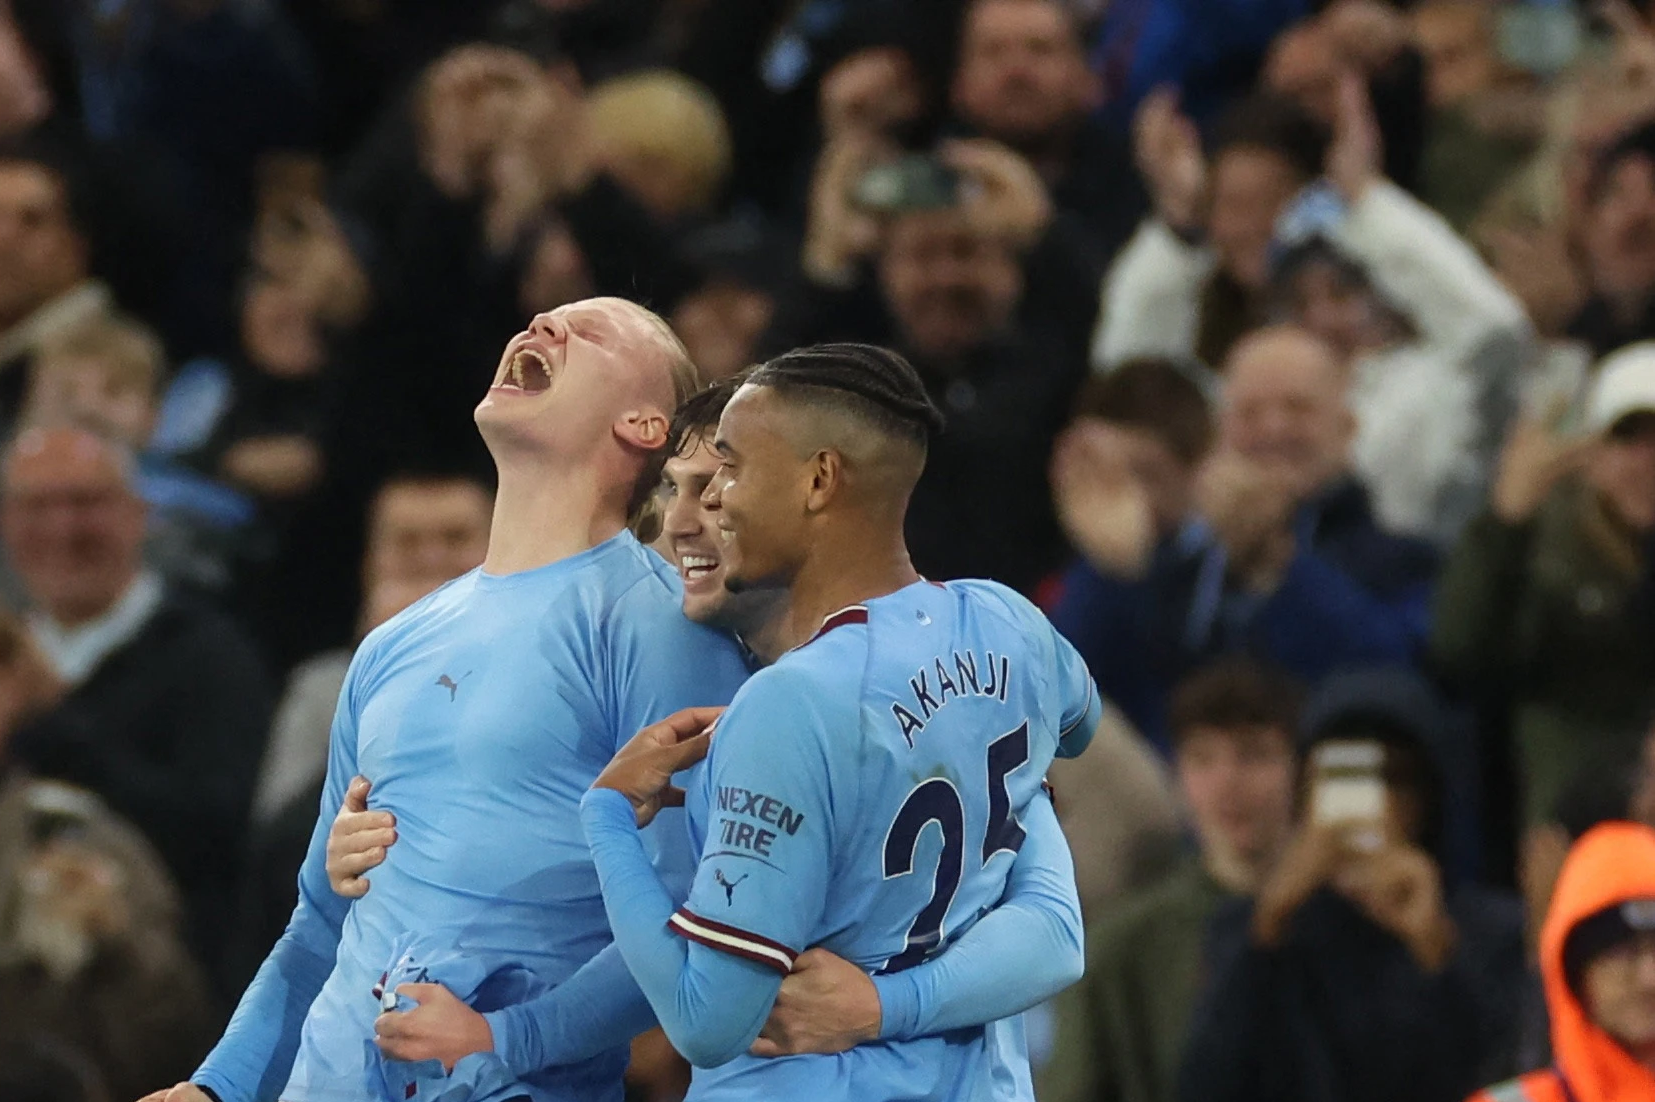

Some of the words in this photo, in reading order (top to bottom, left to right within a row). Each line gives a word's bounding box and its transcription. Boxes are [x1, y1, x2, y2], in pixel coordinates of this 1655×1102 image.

[891, 649, 1009, 751] AKANJI
[716, 785, 805, 837] NEXEN
[719, 818, 777, 858] TIRE
[872, 717, 1030, 977] 25
